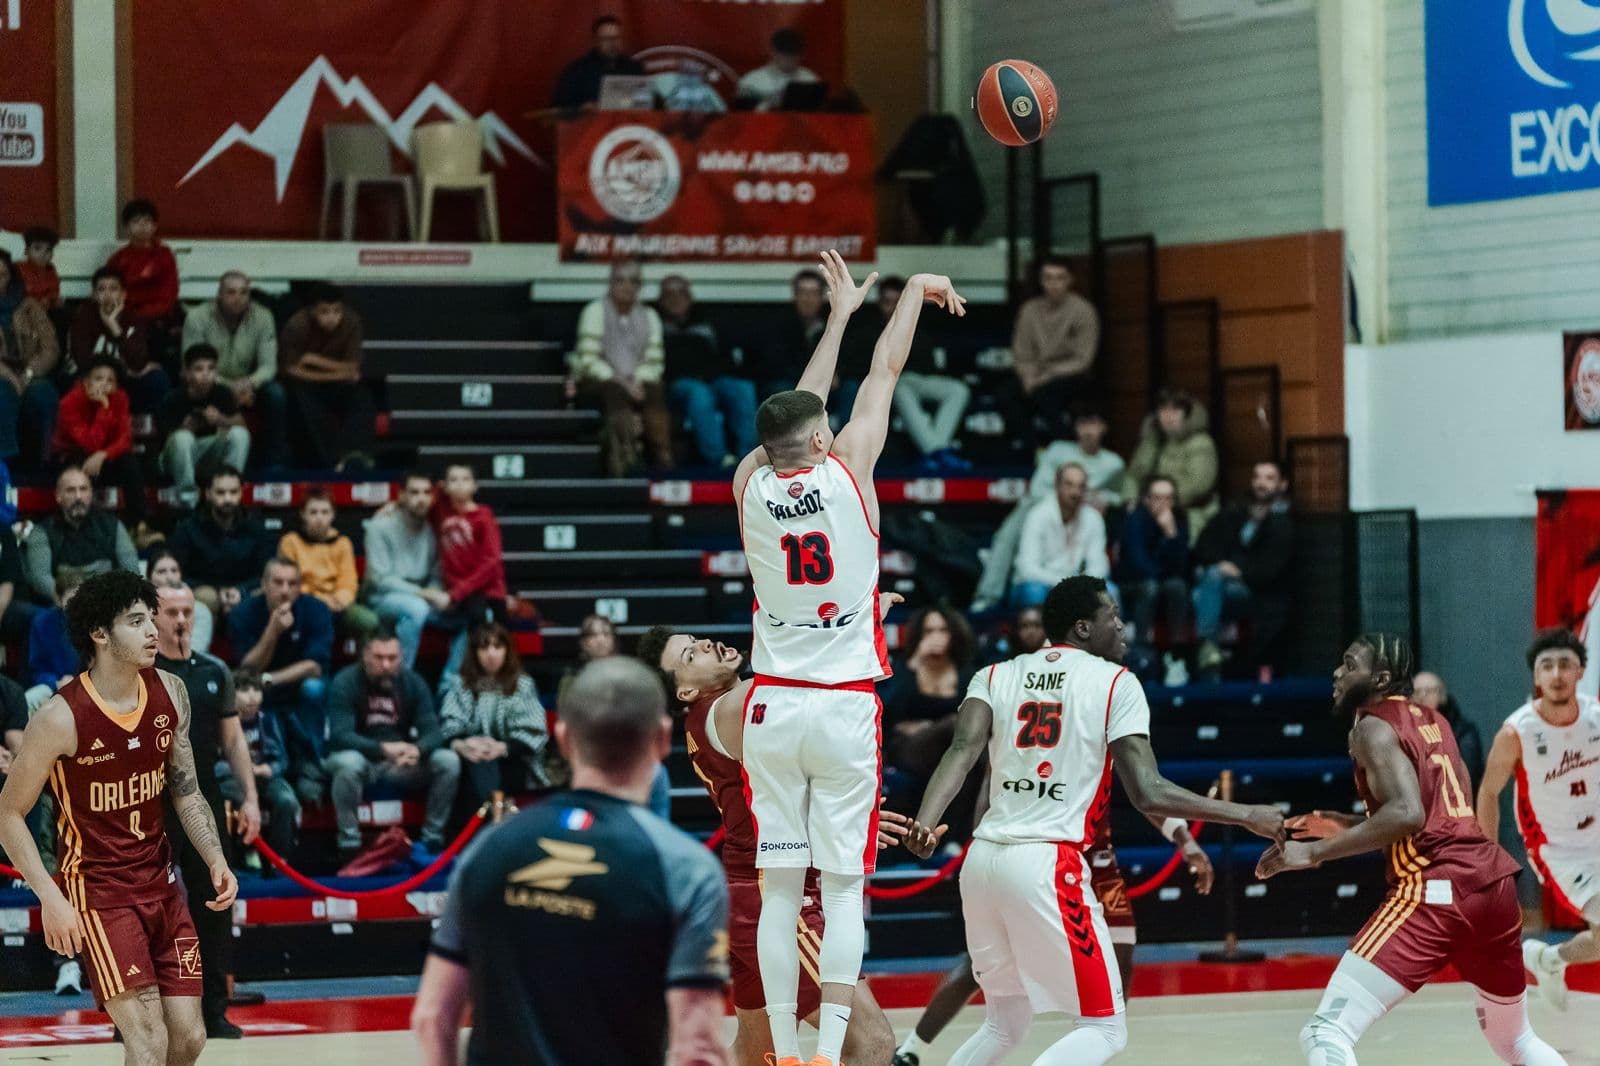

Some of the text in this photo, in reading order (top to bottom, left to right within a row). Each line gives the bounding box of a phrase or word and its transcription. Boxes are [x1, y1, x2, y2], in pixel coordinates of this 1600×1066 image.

[780, 531, 834, 585] 13
[1024, 672, 1066, 691] SANE
[750, 703, 767, 725] 13
[1016, 701, 1063, 749] 25
[90, 761, 165, 812] ORLÉANS
